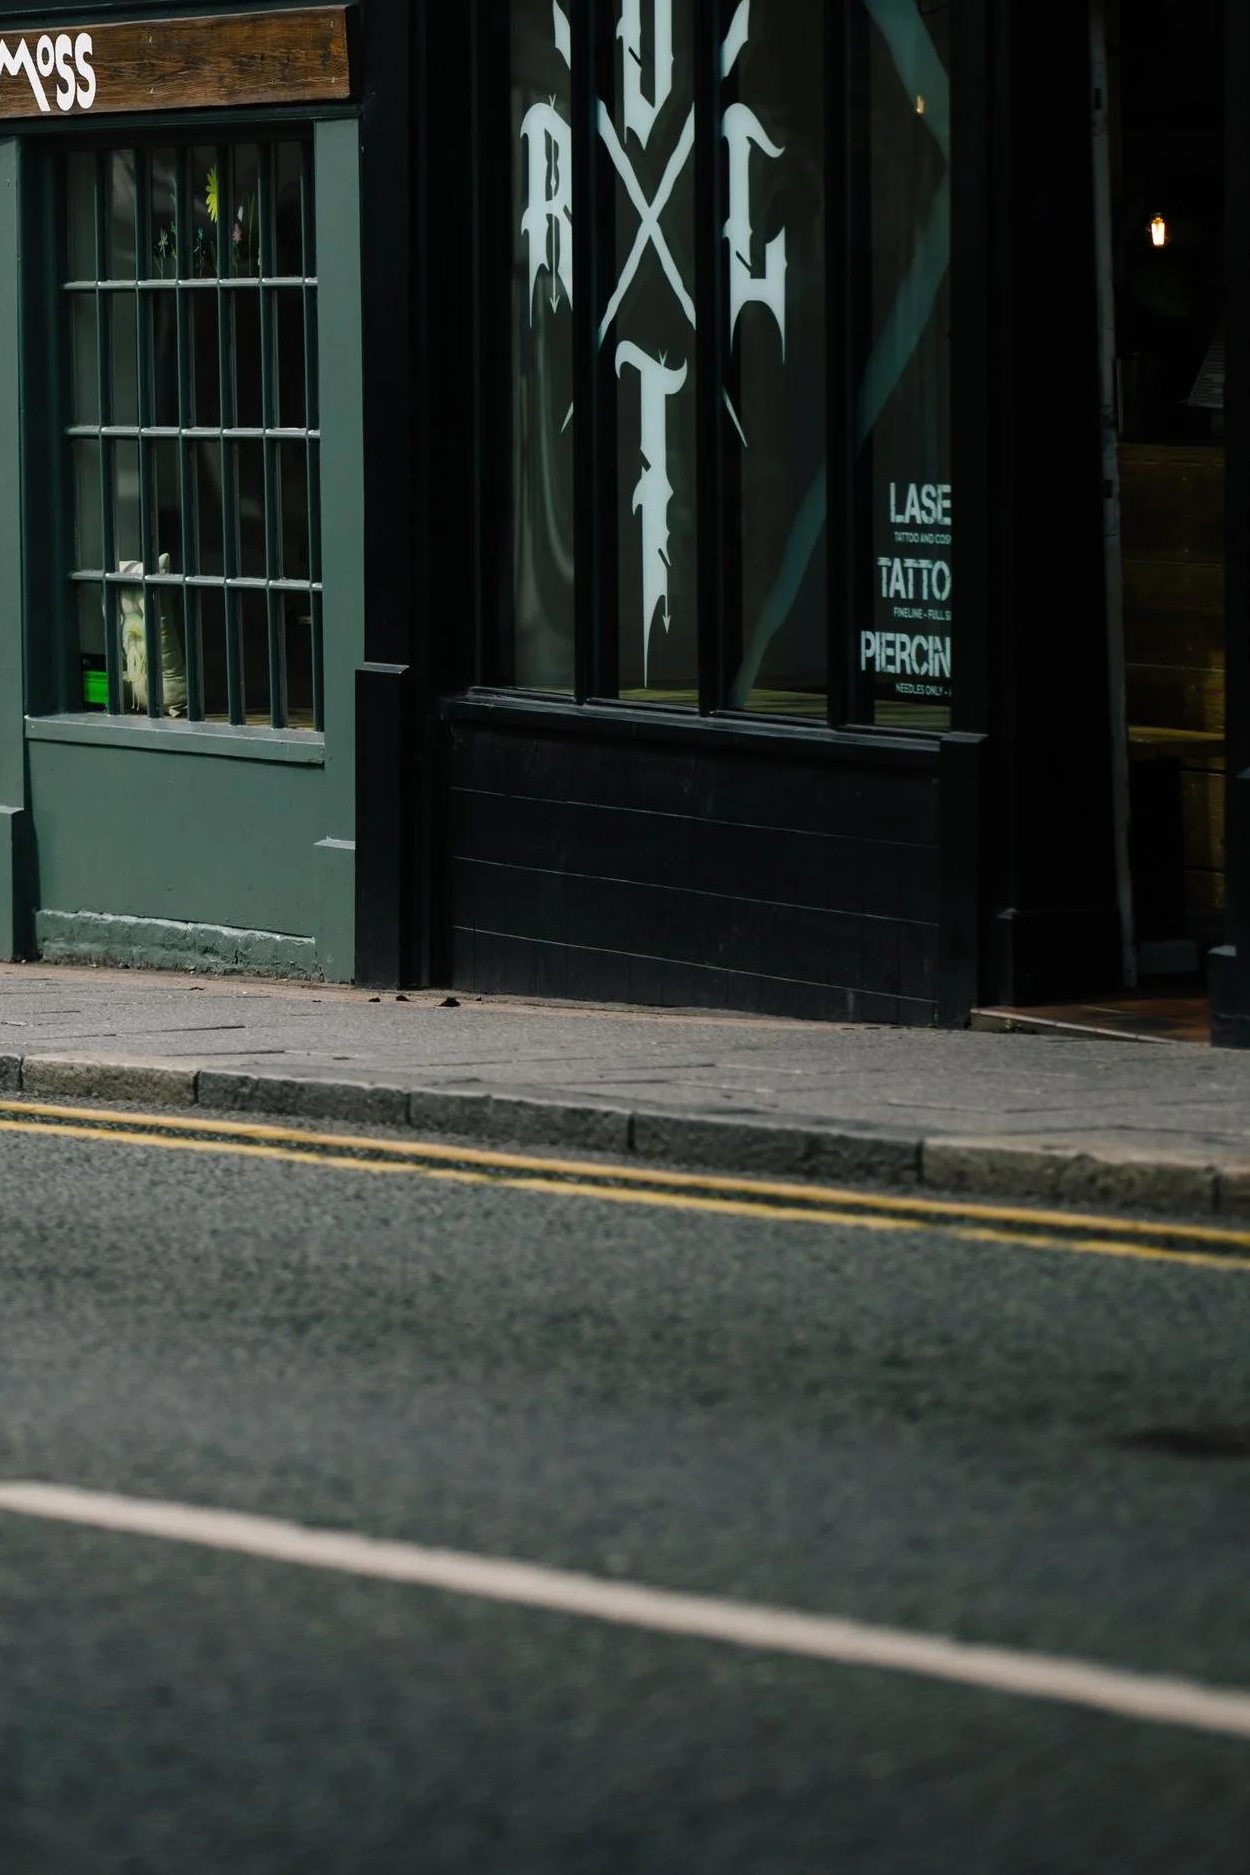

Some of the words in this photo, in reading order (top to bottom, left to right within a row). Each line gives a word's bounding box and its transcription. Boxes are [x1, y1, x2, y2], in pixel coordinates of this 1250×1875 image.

[889, 482, 951, 526] LASE
[894, 531, 919, 544] TATTOO
[920, 532, 934, 545] AND
[877, 557, 951, 602] TATTO
[893, 607, 923, 620] FINELINE
[860, 630, 951, 678] PIERCIN
[895, 682, 925, 695] NEEDLES
[926, 684, 944, 697] ONLY
